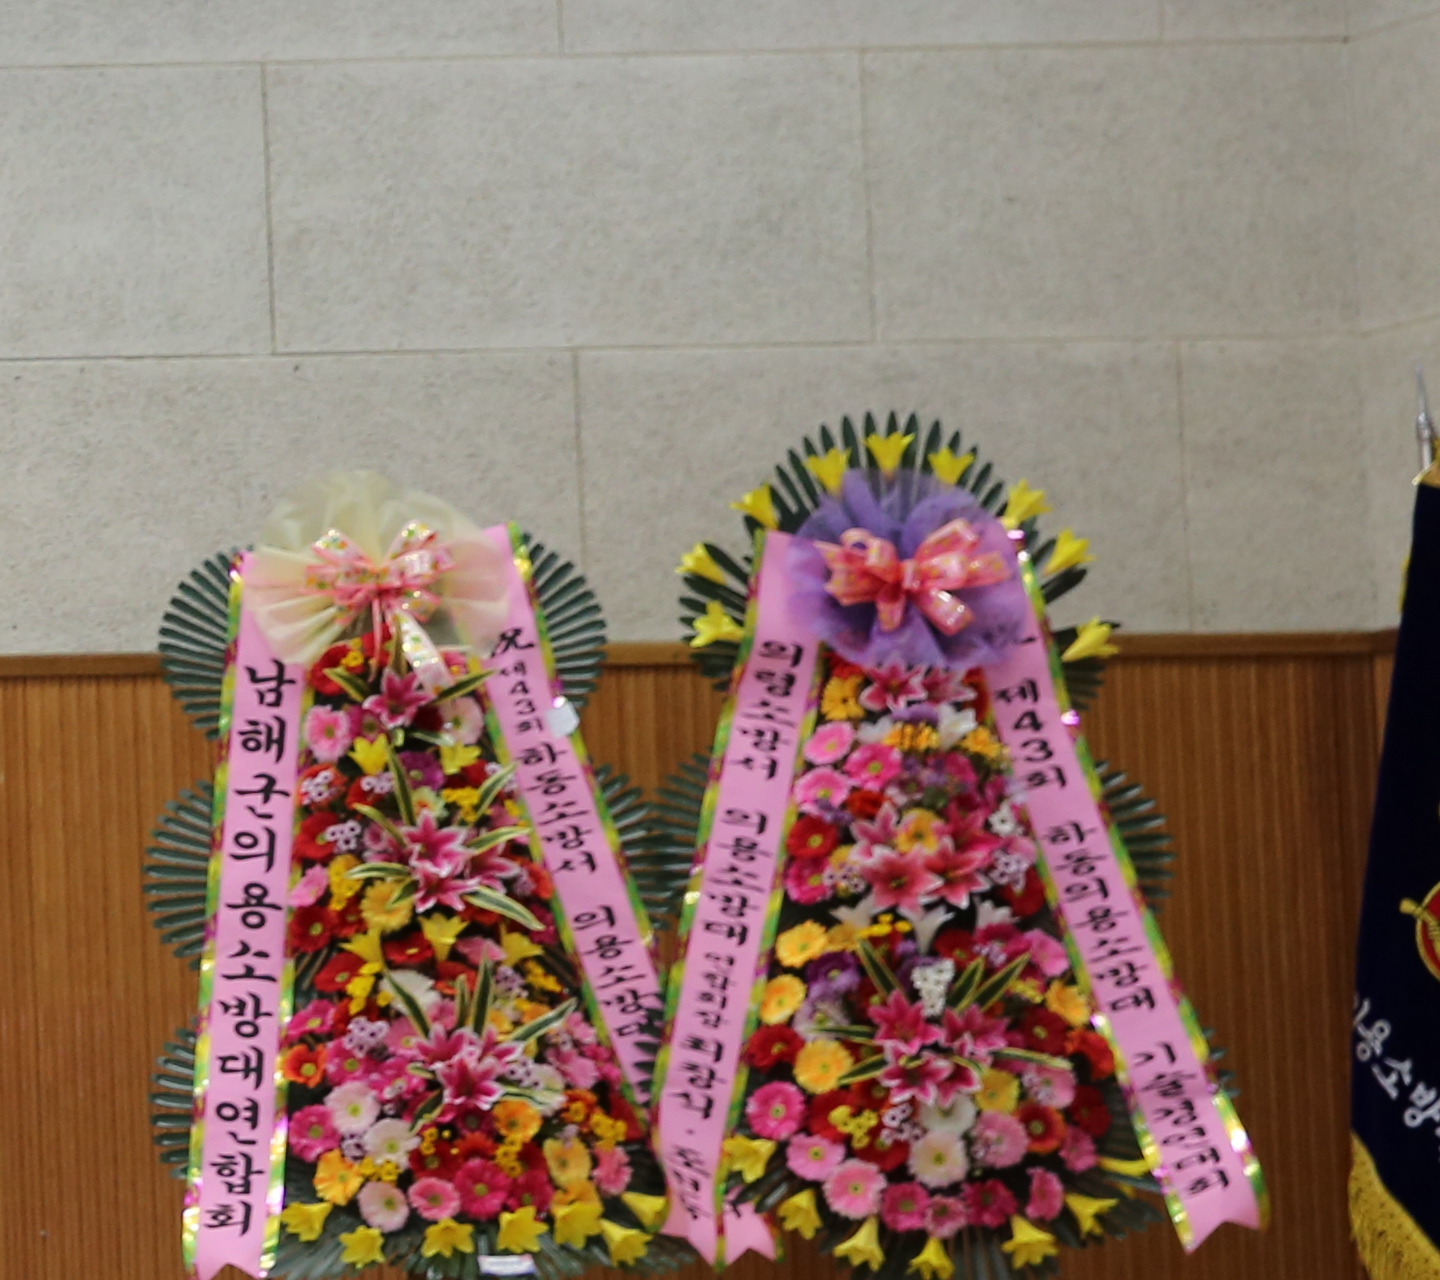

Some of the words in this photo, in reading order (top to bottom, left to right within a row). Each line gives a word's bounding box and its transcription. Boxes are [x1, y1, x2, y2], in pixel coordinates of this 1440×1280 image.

[514, 740, 599, 874] 하동소방서
[996, 678, 1066, 789] 제43회
[1044, 822, 1156, 1014] 하동의용소방대
[704, 809, 767, 947] 의용소방대
